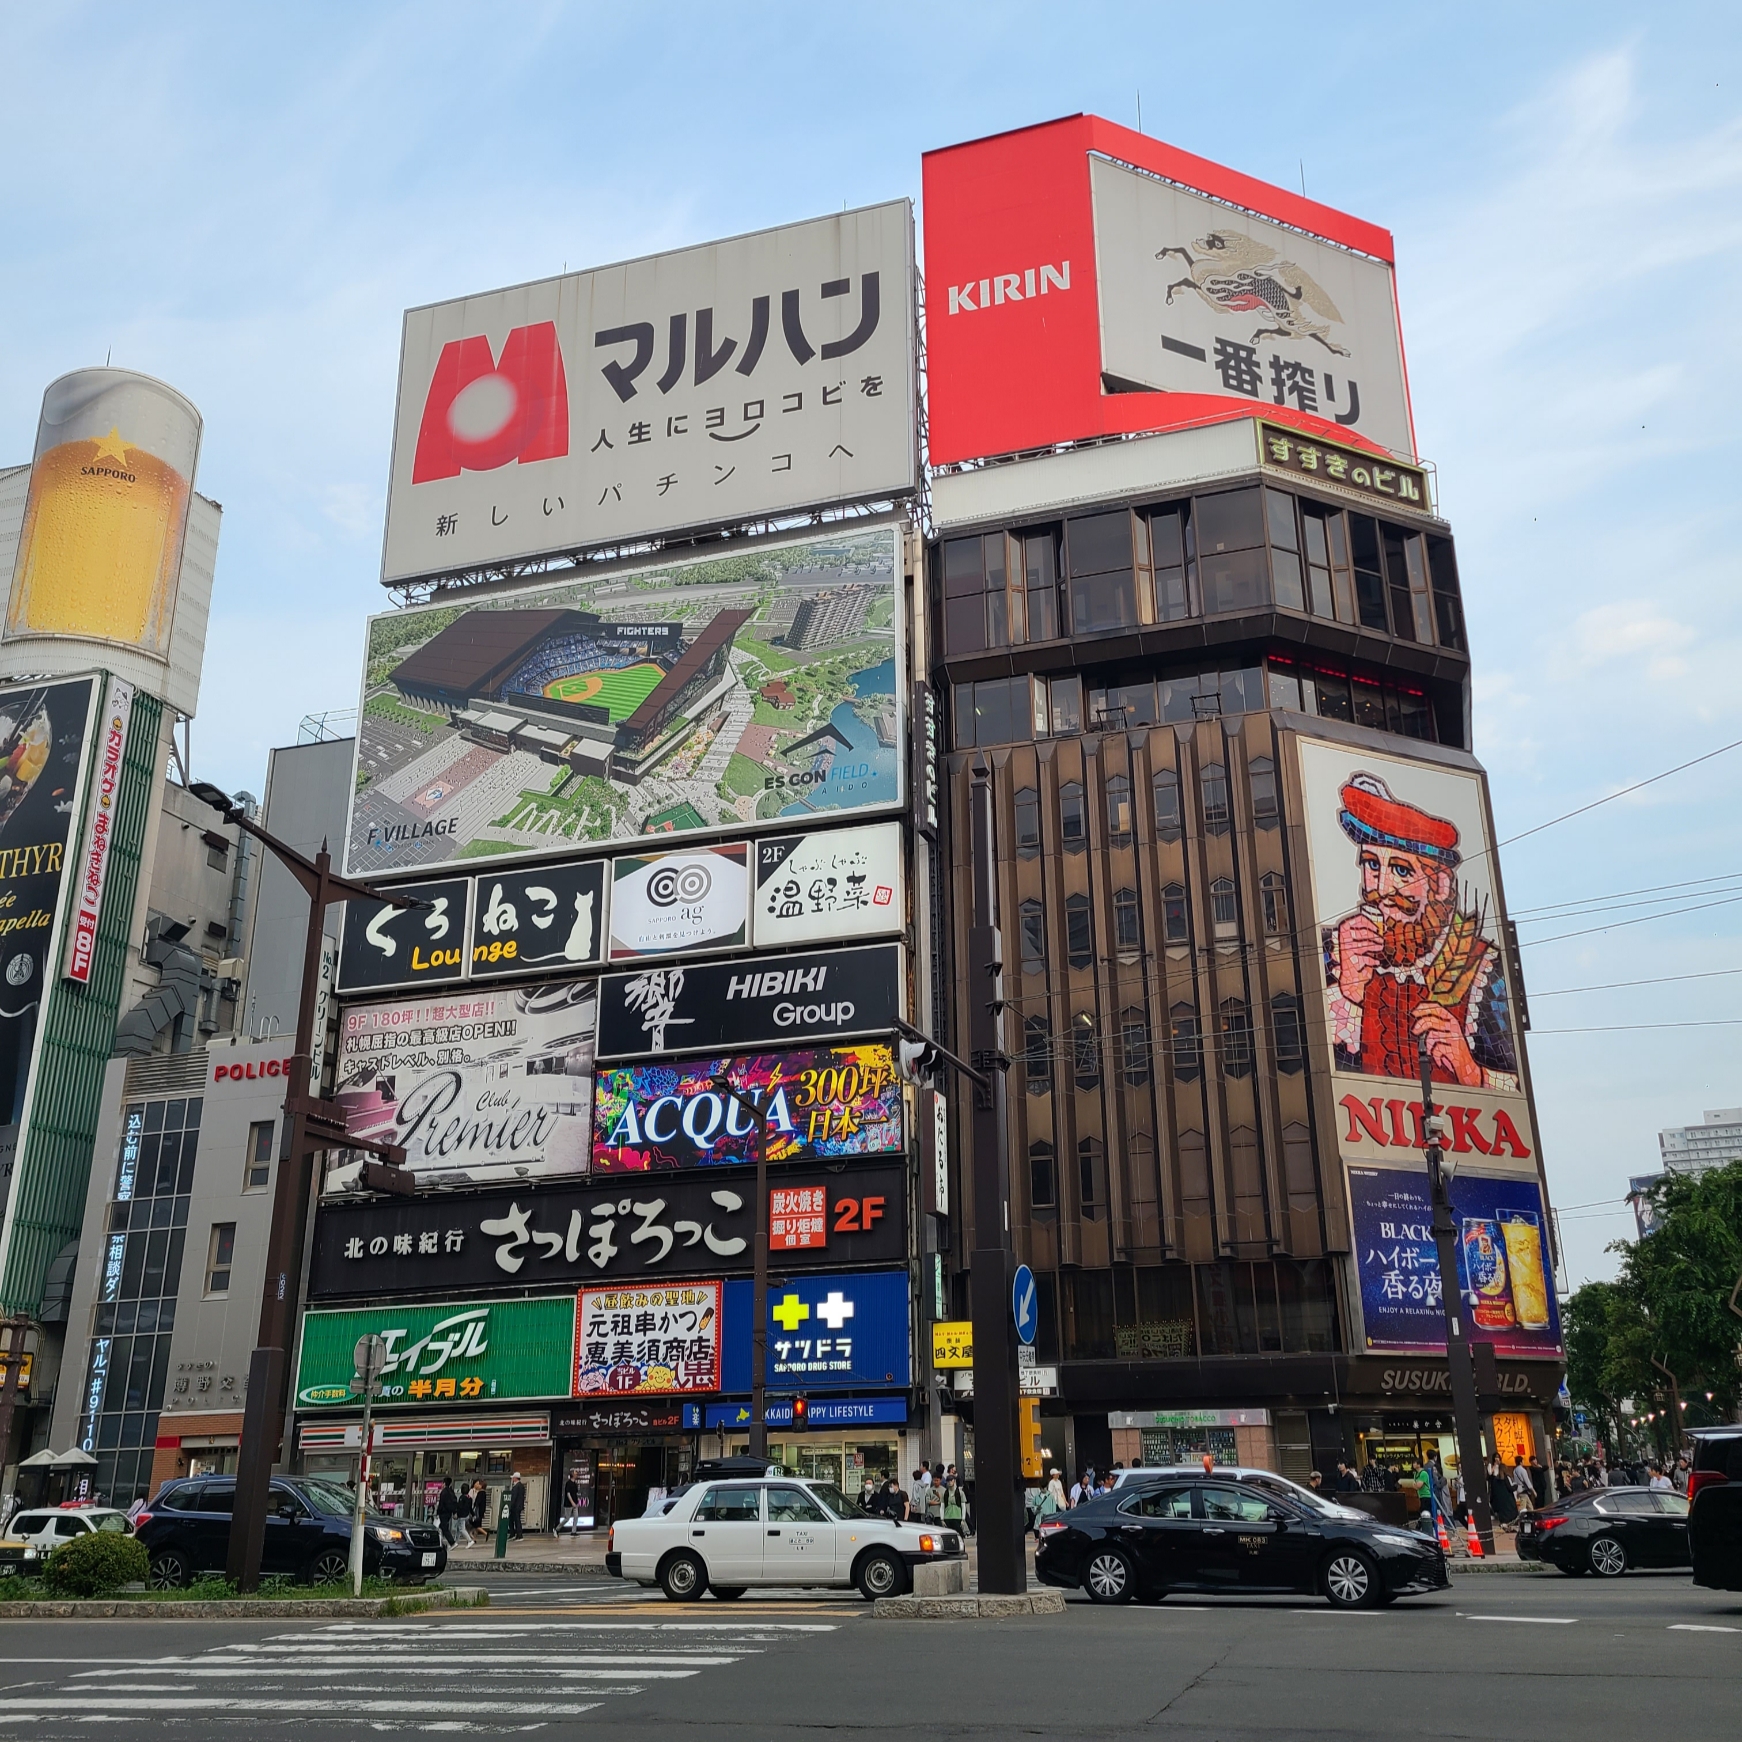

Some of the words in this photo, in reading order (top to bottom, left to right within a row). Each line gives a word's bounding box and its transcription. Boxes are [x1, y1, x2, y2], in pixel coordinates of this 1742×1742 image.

[948, 260, 1071, 316] KIRIN
[594, 270, 880, 404] マルハン
[590, 374, 885, 455] 人生にヨロコビを
[80, 465, 137, 484] SAPPORO
[1267, 436, 1421, 503] すすきのビル
[434, 443, 855, 537] 新しいパチンコへ
[616, 624, 669, 637] FIGHTERS
[104, 726, 124, 796] カラオケ
[764, 775, 785, 791] ES
[788, 769, 827, 787] CON
[830, 762, 869, 782] FIELD
[383, 817, 459, 843] VILLAGE
[762, 845, 785, 864] 2F
[79, 915, 95, 930] 受付
[366, 884, 558, 957] くろねこ
[73, 931, 92, 973] 8F
[411, 940, 518, 970] Lounge
[726, 966, 827, 1000] HIBIKI
[347, 1016, 367, 1031] 9F
[772, 1001, 855, 1026] Group
[214, 1058, 290, 1082] POLICE
[795, 1065, 890, 1107] 300坪
[475, 1090, 511, 1112] Club
[605, 1086, 795, 1148] ACQUA
[807, 1107, 889, 1143] 日本一
[834, 1196, 886, 1232] 2F
[344, 1230, 465, 1259] 北の味紀行
[480, 1190, 747, 1273] さっぽろっこ
[1380, 1222, 1434, 1242] BLACK
[1381, 1270, 1442, 1300] 香る夜
[604, 1290, 696, 1310] 昼飲みの聖地
[1379, 1306, 1399, 1315] ENJOY
[586, 1311, 697, 1338] 元祖串かつ
[774, 1338, 852, 1360] サツドラ
[774, 1362, 806, 1373] SAPPORO
[808, 1362, 827, 1371] DRUG
[829, 1361, 852, 1370] STORE
[408, 1377, 485, 1398] 半月分
[616, 1376, 634, 1390] 1F
[589, 1410, 649, 1428] さっぽろっこ
[829, 1405, 874, 1418] LIFESTYLE
